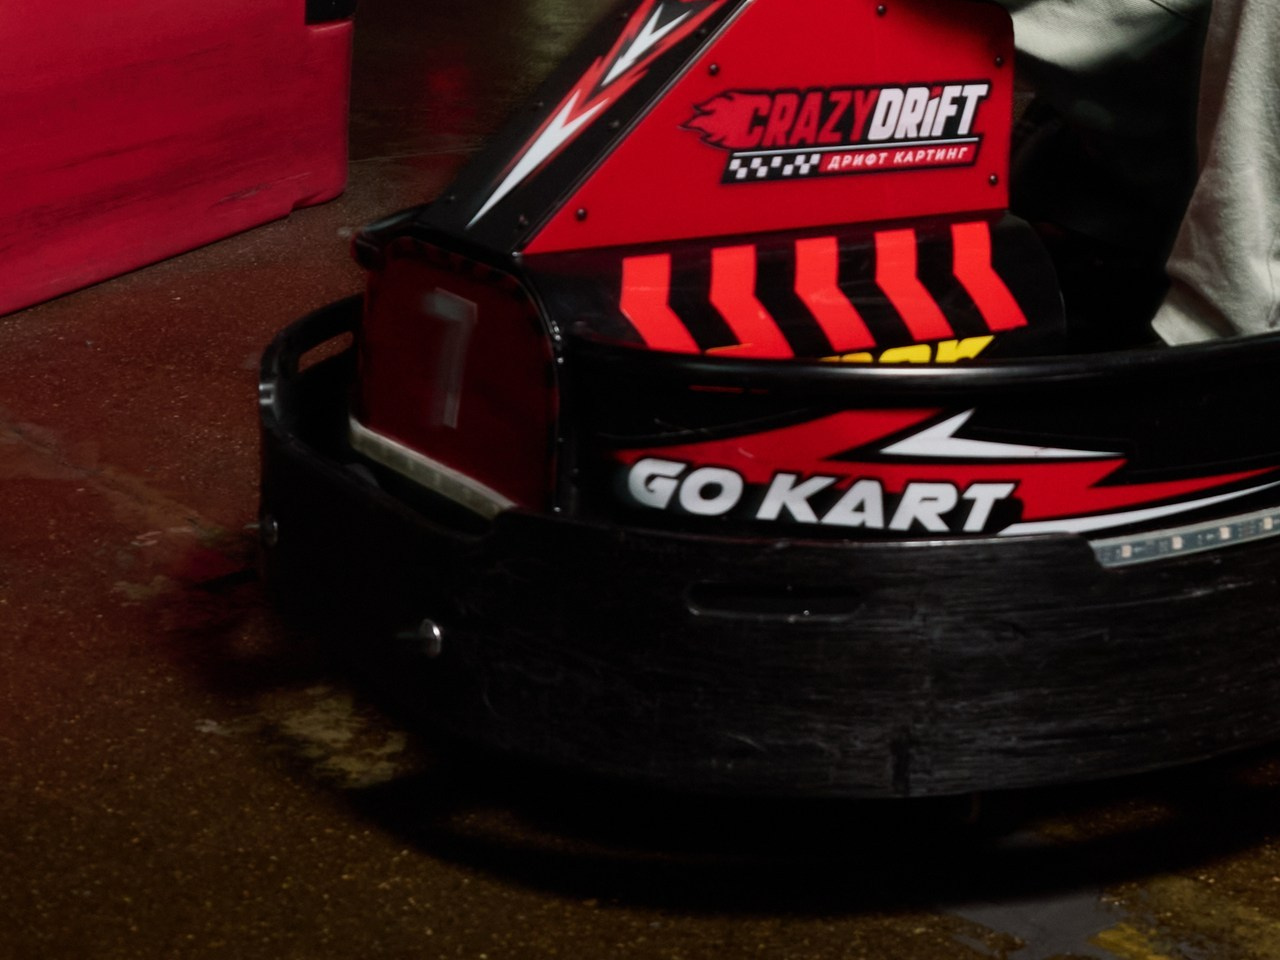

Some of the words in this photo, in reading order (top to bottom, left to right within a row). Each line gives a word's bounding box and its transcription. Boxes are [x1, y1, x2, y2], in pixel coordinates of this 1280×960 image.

[826, 151, 888, 171] ДРИФТ
[893, 146, 969, 165] КАРТИНГ
[627, 457, 745, 517] GO
[754, 472, 1017, 534] KART
